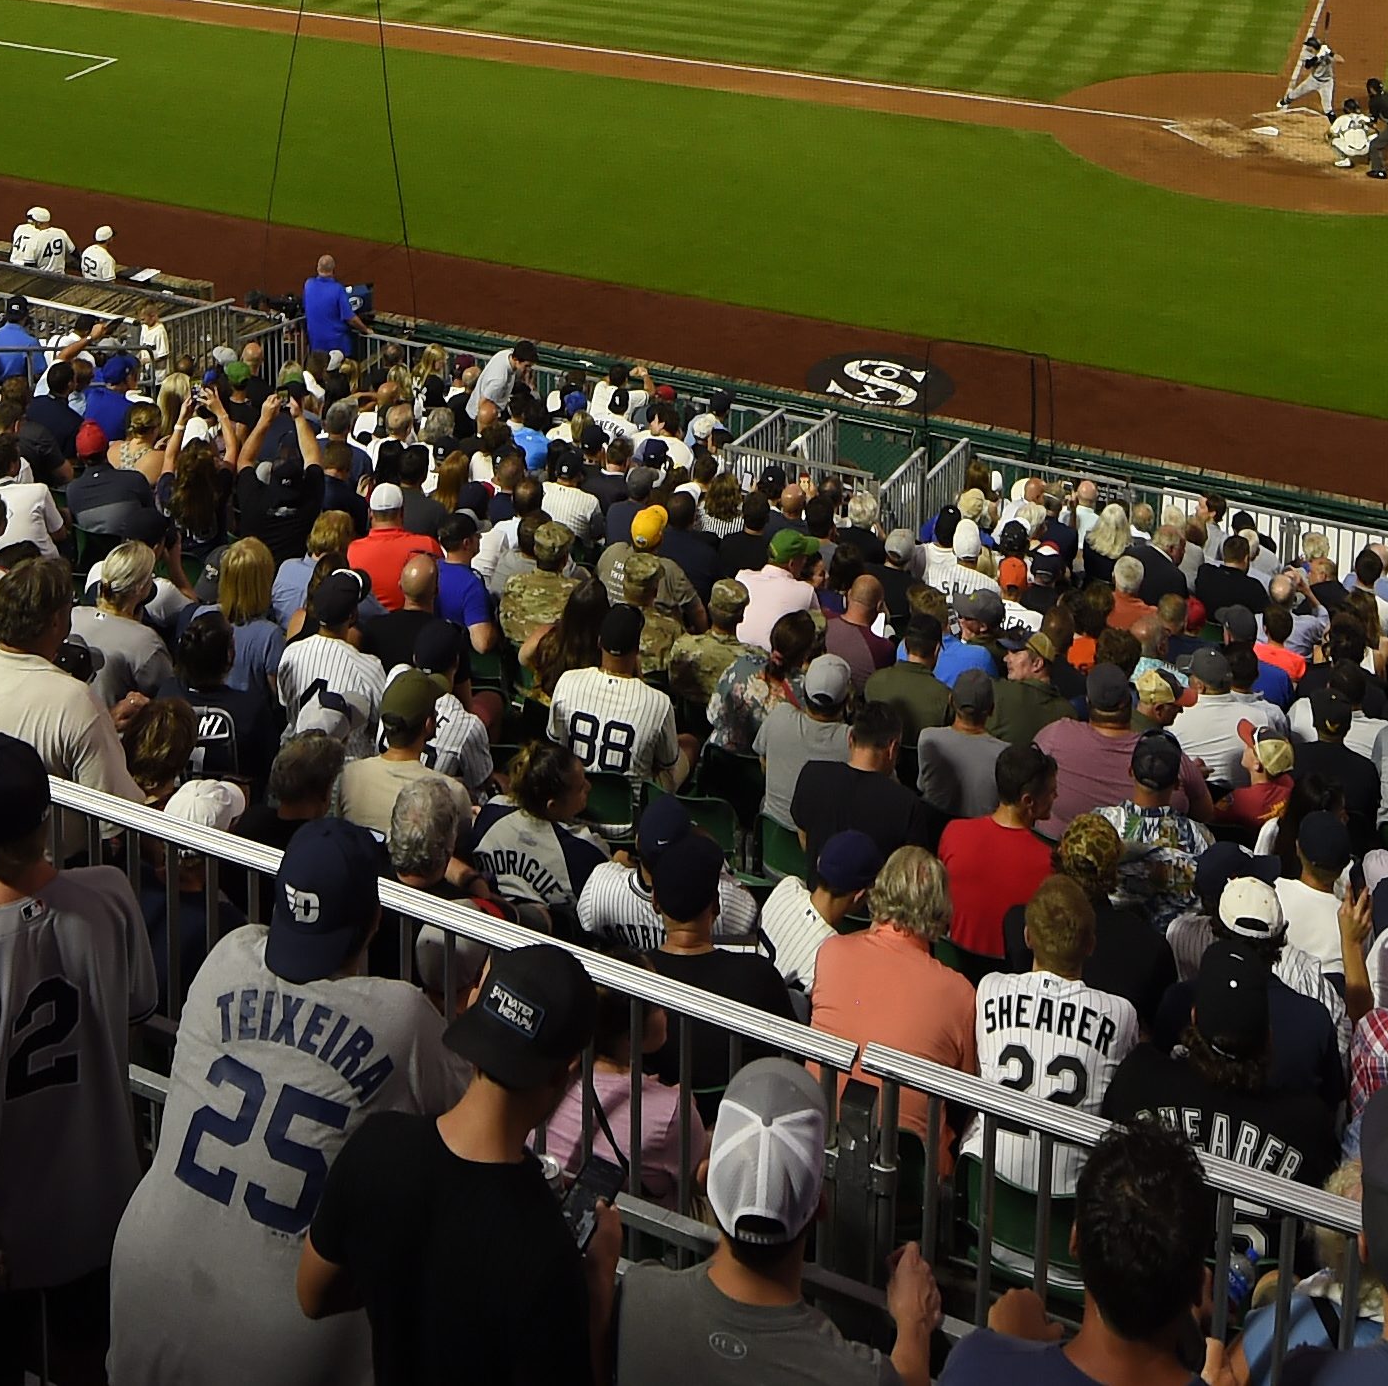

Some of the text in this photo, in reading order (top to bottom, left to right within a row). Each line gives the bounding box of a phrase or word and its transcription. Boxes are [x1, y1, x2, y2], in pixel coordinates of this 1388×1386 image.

[43, 238, 63, 259] 49
[83, 256, 98, 278] 52
[569, 710, 637, 774] 88
[490, 984, 534, 1017] SALTWATER
[983, 993, 1117, 1058] SHEARER
[4, 973, 83, 1102] 2
[216, 987, 395, 1105] TEIXEIRA
[996, 1043, 1089, 1126] 22
[174, 1053, 353, 1236] 25
